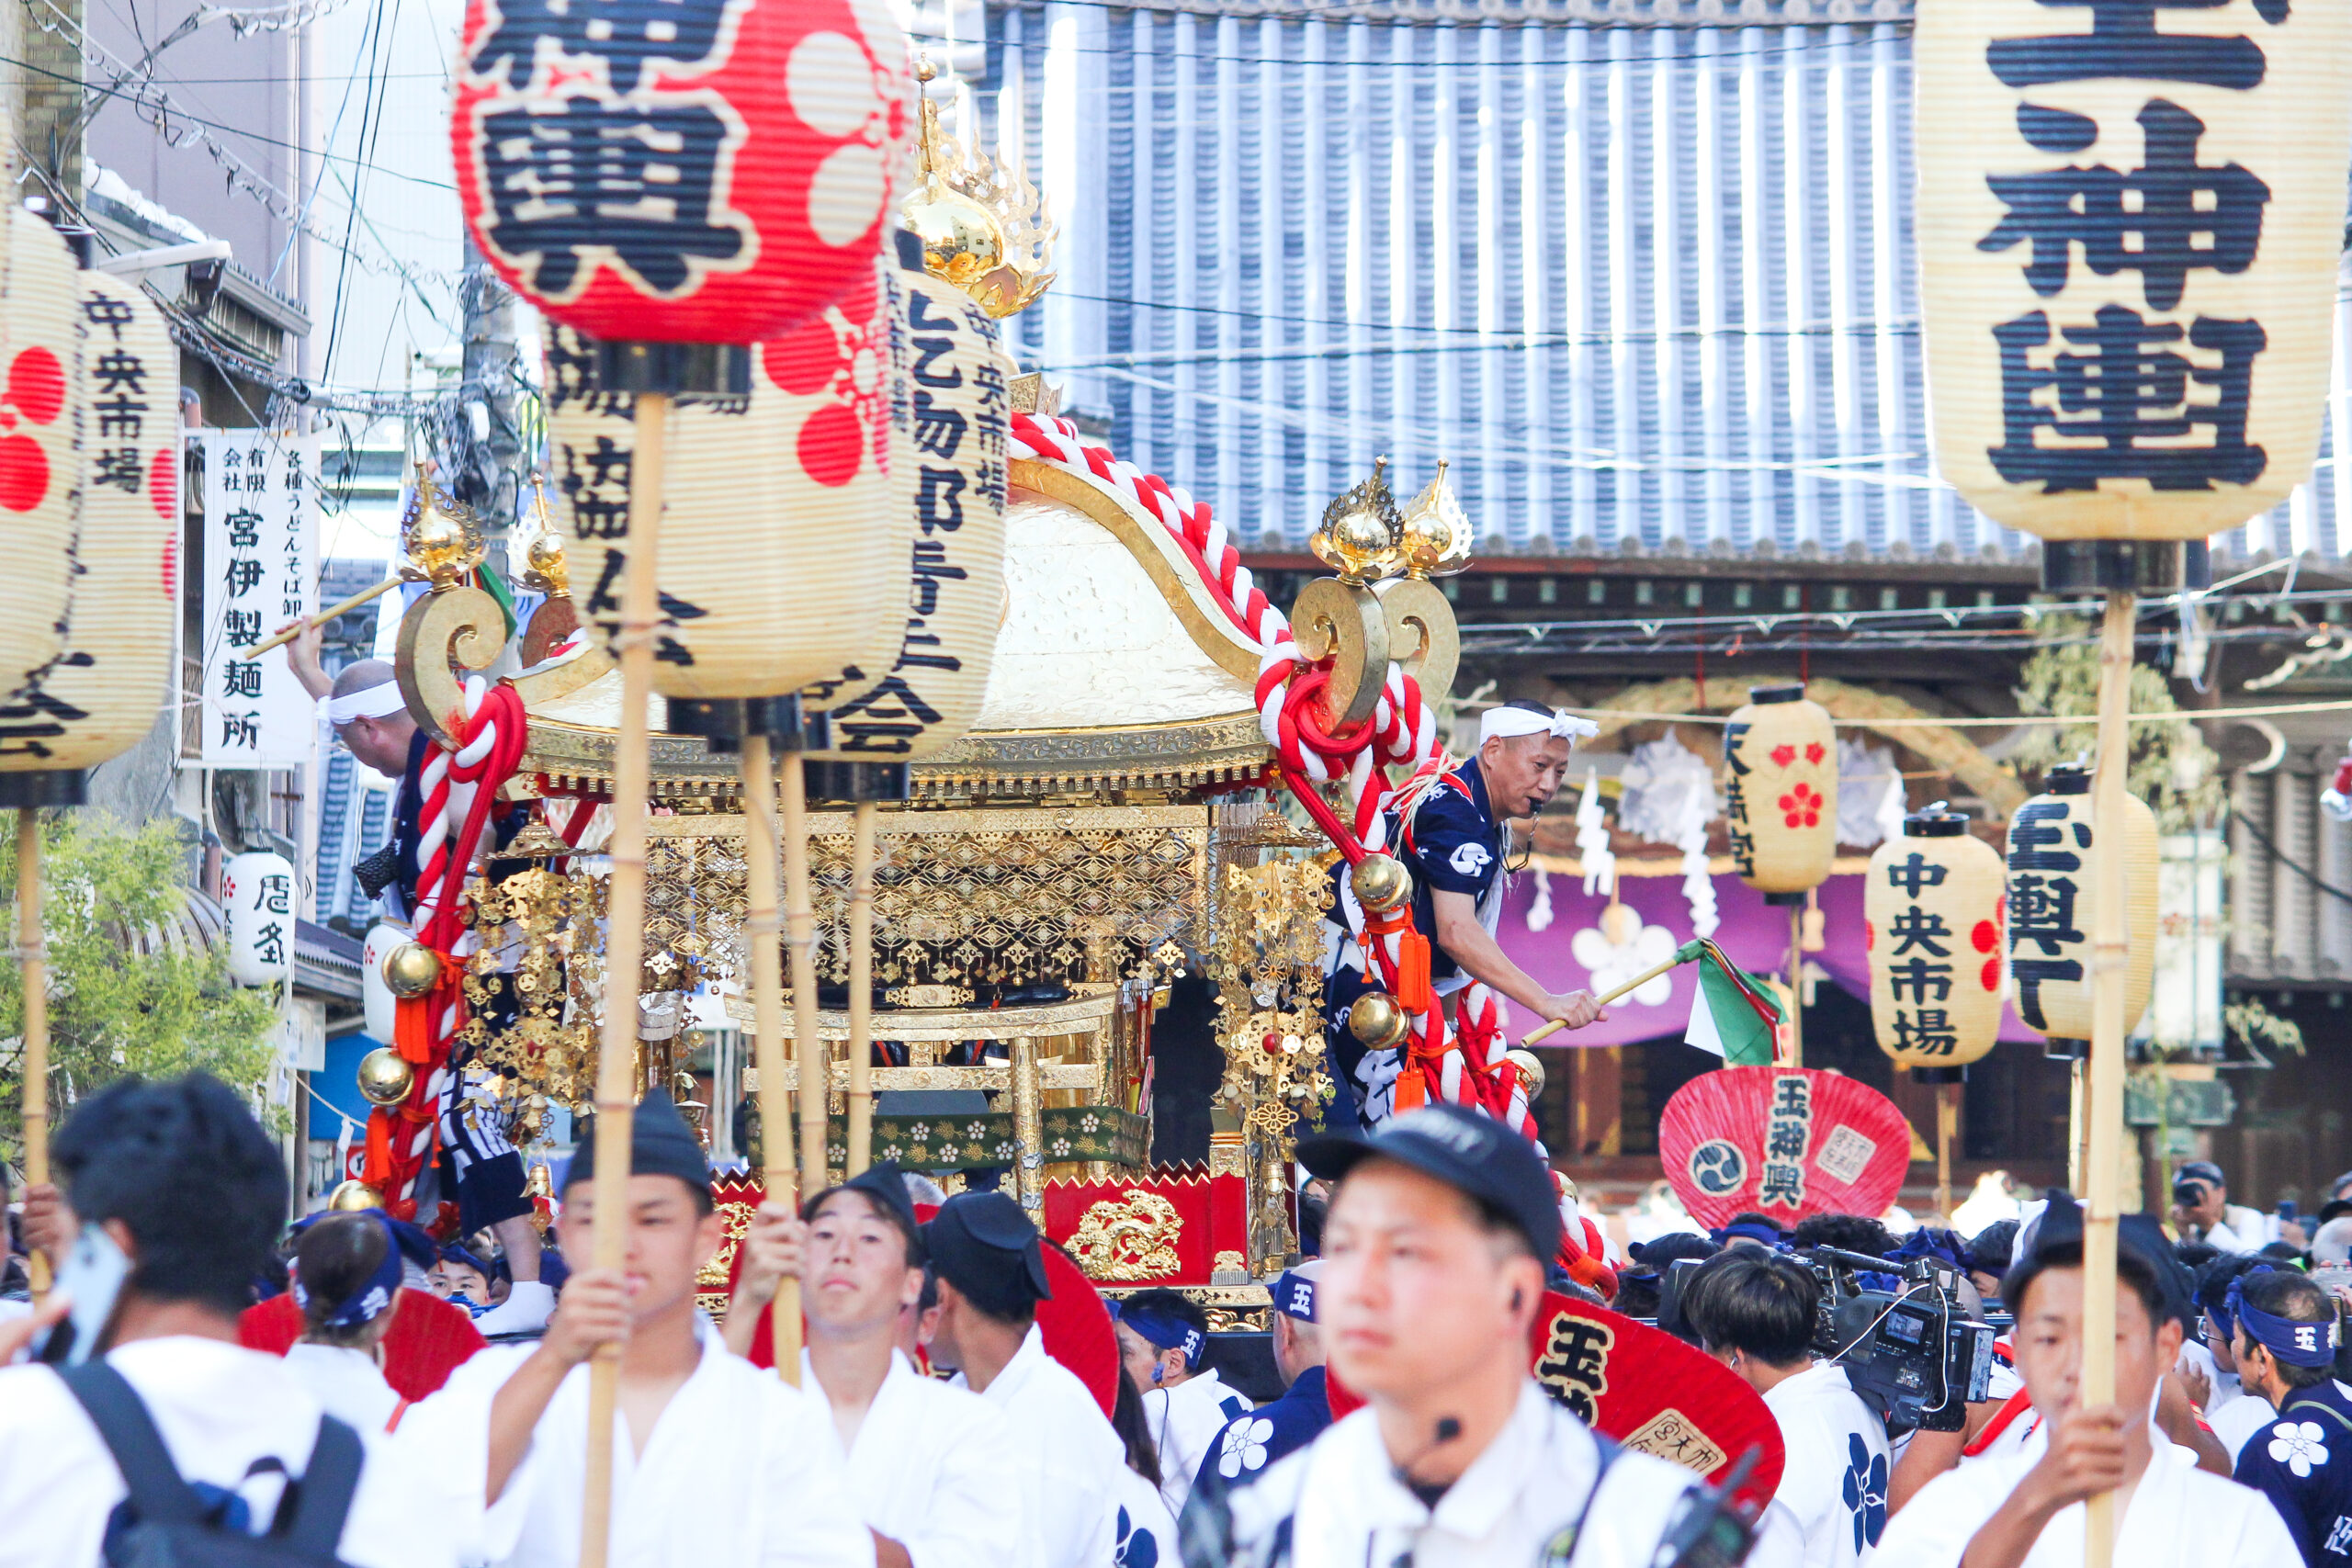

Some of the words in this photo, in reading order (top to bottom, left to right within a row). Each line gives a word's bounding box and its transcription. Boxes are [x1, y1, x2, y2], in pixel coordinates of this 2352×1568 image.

[81, 290, 149, 494] 中央市場
[963, 301, 1007, 516] 中央市場
[283, 449, 303, 617] 各種うどんそば卸
[221, 507, 266, 750] 宮伊製麺所
[1887, 852, 1959, 1056] 中央市場
[1762, 1077, 1809, 1207] 玉神輿
[1180, 1328, 1201, 1359] 玉
[1289, 1282, 1313, 1316] 玉
